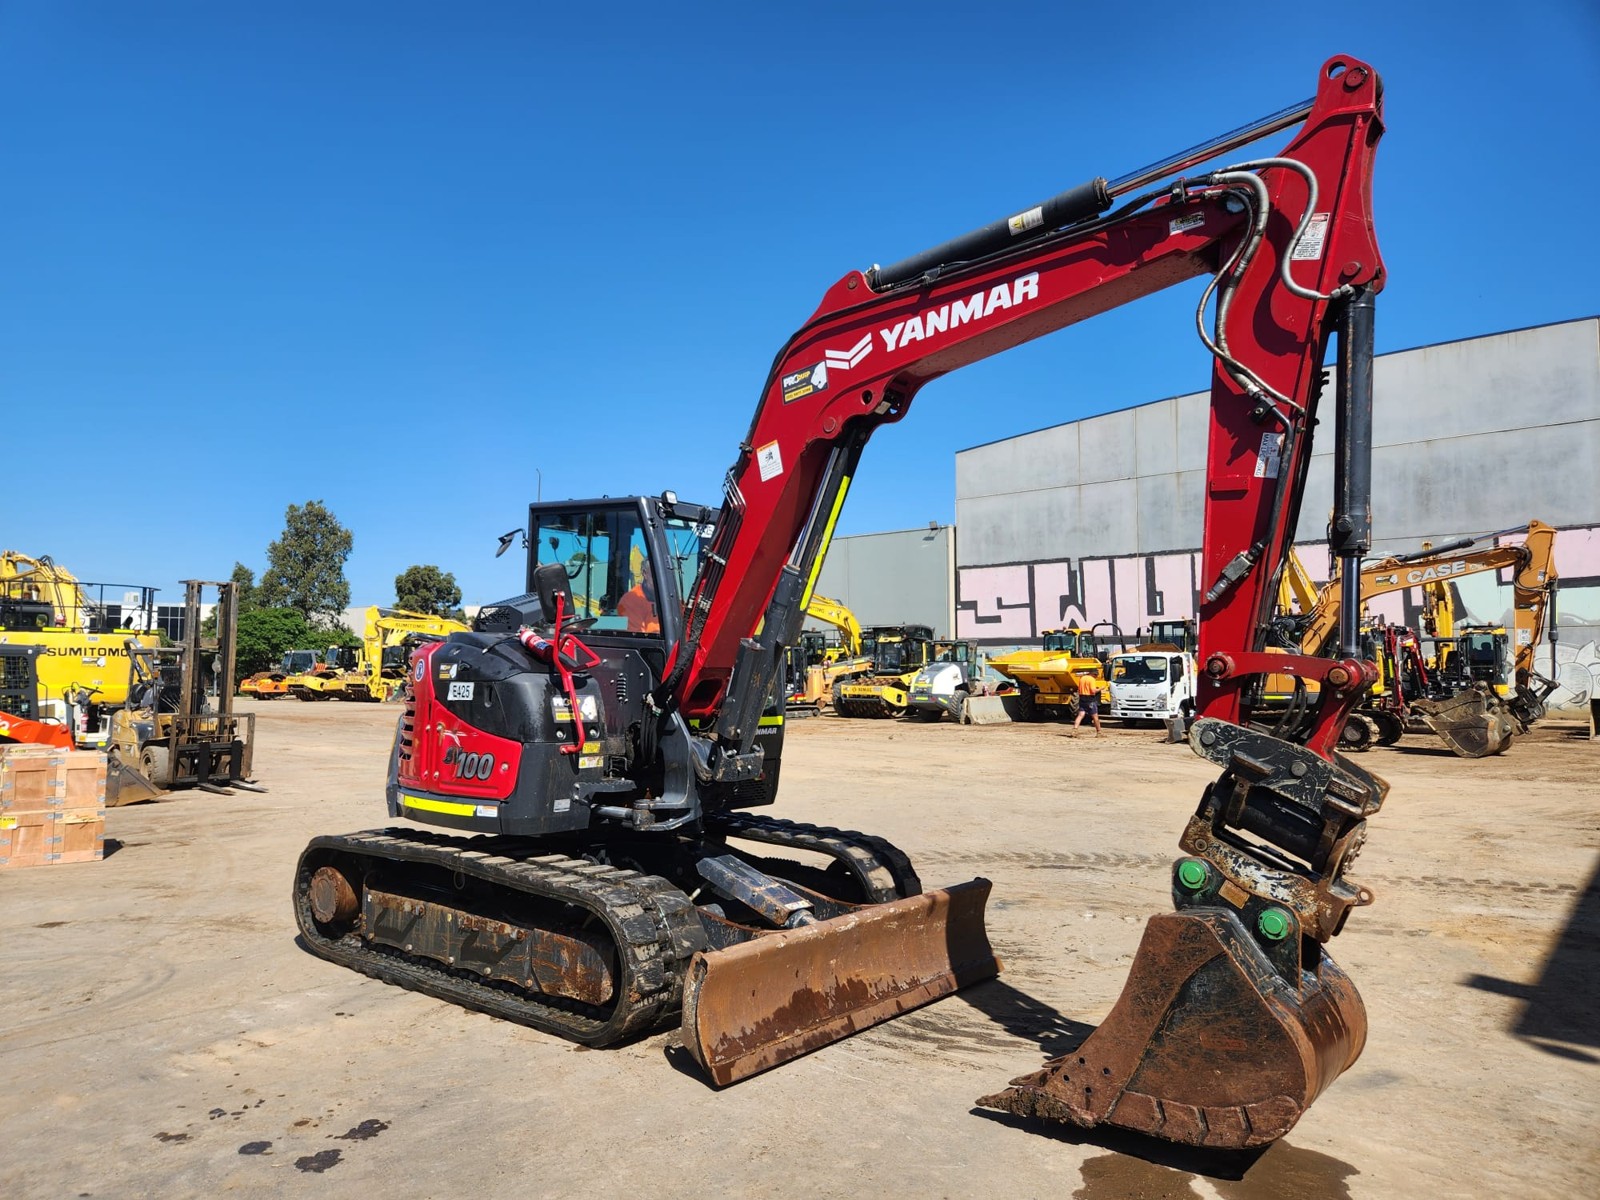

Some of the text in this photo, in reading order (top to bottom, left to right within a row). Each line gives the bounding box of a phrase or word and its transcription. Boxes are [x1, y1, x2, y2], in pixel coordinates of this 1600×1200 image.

[879, 271, 1039, 353] YANMAR
[1406, 560, 1466, 583] CASE
[452, 685, 470, 698] E425
